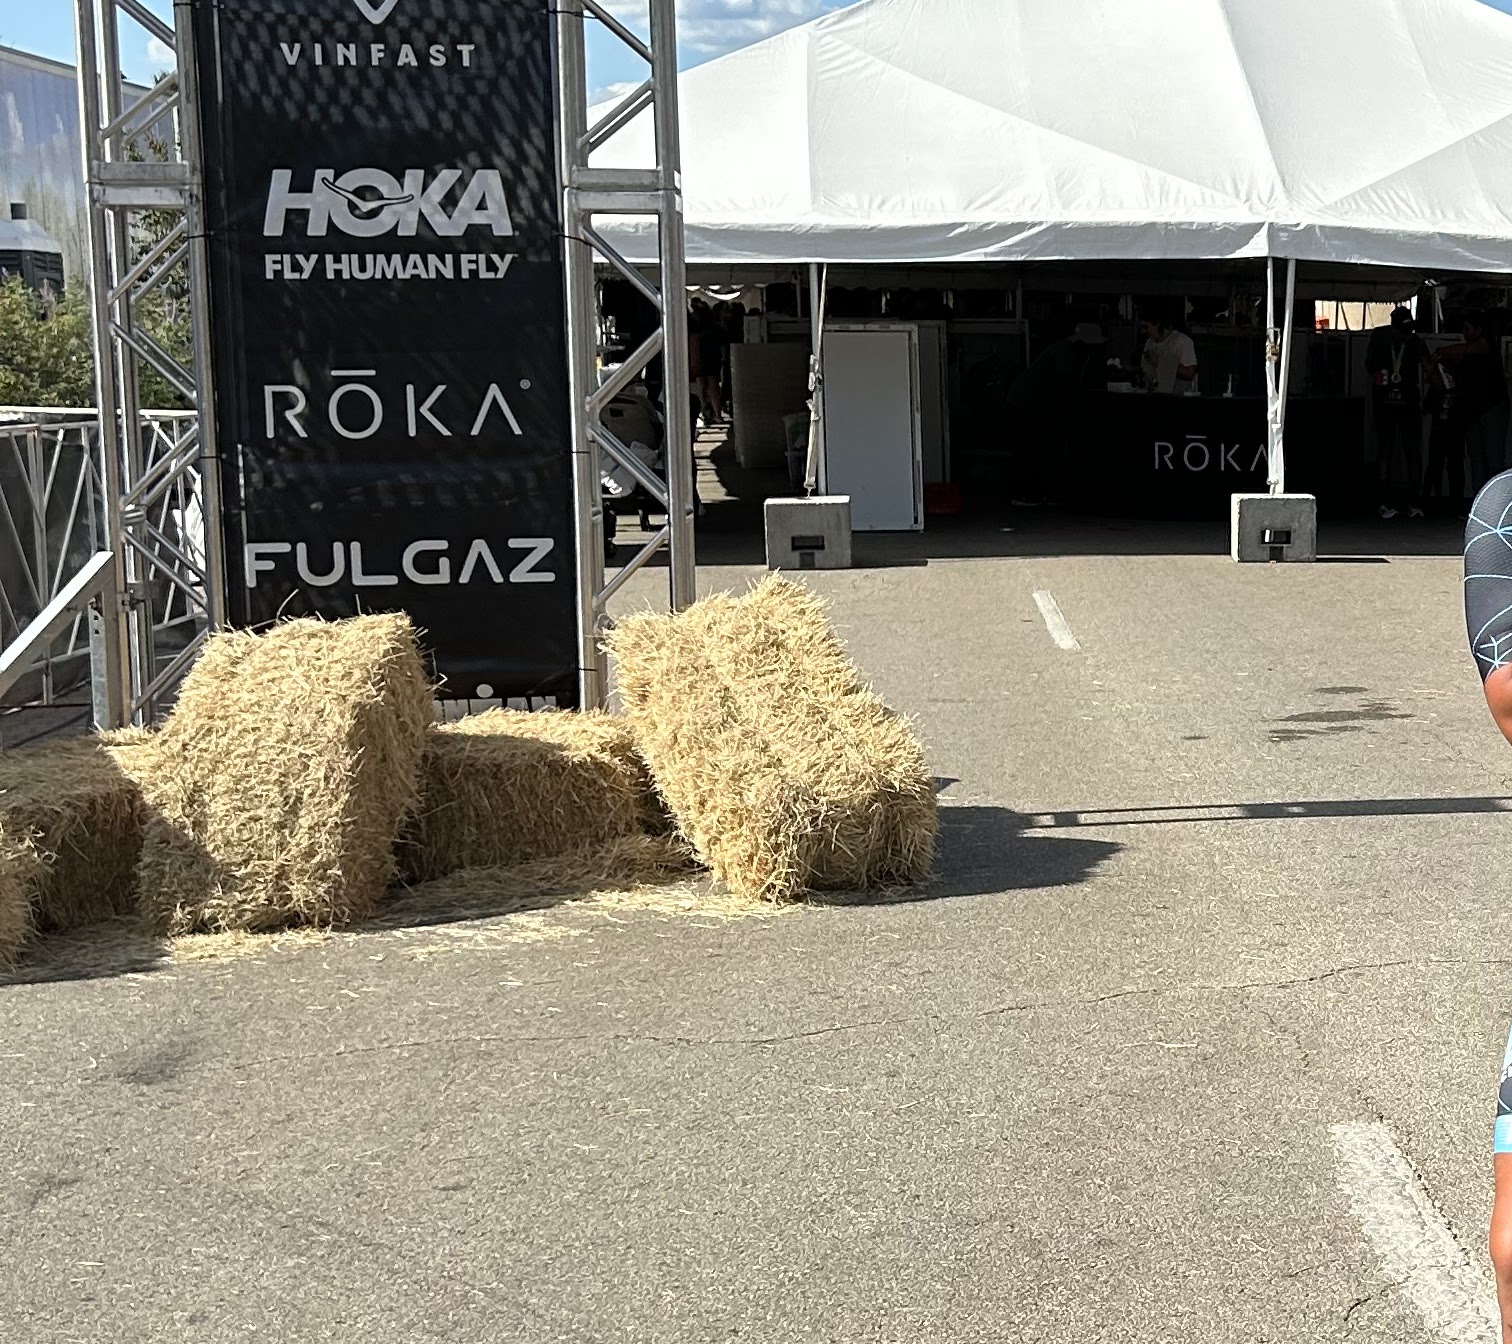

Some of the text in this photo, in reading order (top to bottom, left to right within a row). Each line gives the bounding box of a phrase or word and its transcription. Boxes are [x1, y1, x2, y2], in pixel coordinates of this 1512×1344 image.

[280, 42, 476, 67] VINFAST
[263, 167, 515, 238] HOKA
[265, 254, 514, 280] FLY HUMAN FLY
[245, 537, 556, 588] FULGAZ
